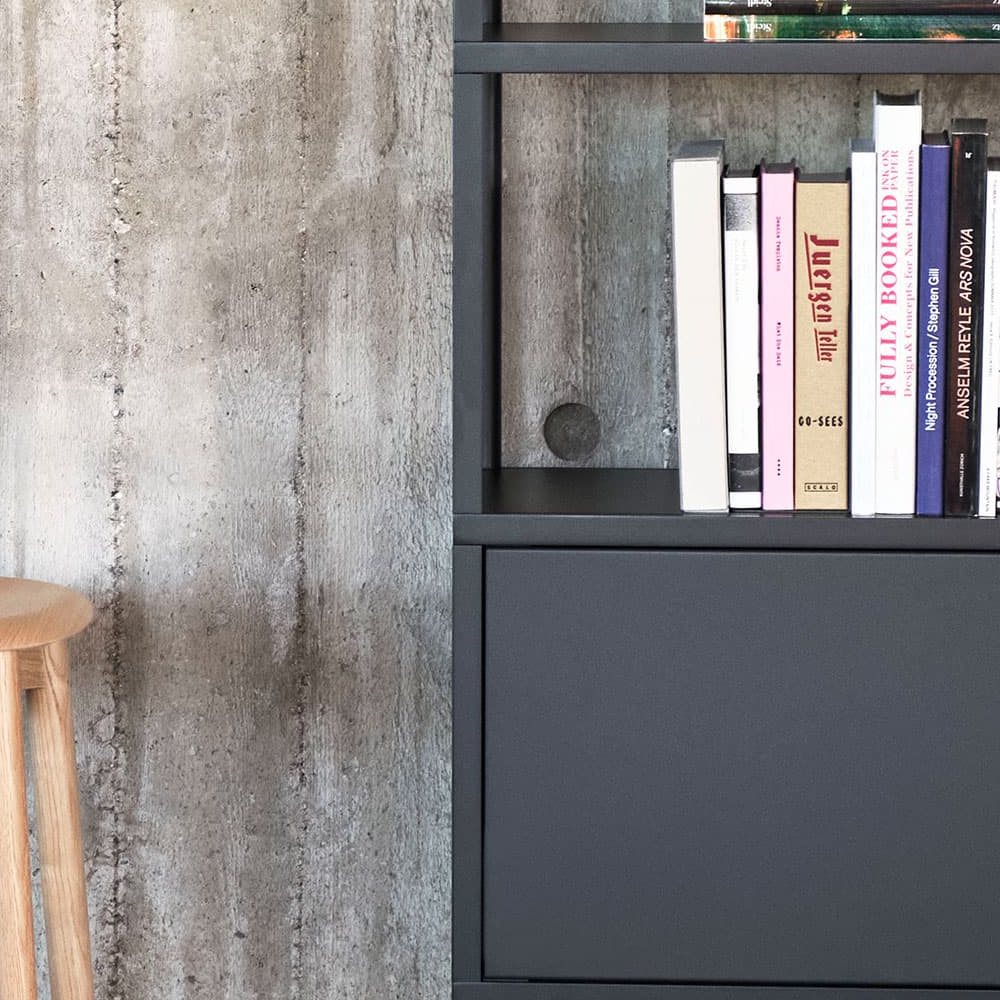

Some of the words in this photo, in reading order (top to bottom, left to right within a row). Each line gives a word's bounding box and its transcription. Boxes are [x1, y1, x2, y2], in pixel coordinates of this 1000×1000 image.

[881, 150, 890, 167] ON
[890, 150, 899, 190] PAPER
[881, 170, 889, 190] INK
[904, 149, 915, 226] Publications
[880, 195, 898, 304] BOOKED
[904, 231, 913, 256] New
[960, 228, 974, 269] NOVA
[807, 233, 839, 322] Juergen
[904, 261, 913, 279] for
[928, 268, 940, 286] Gill
[959, 270, 973, 302] ARS
[904, 282, 915, 338] Concepts
[927, 287, 940, 332] Stephen
[817, 329, 838, 362] Teller
[905, 343, 912, 352] &
[958, 307, 972, 353] REYLE
[880, 315, 897, 397] FULLY
[925, 341, 938, 401] Procession
[904, 356, 915, 397] Design
[957, 357, 971, 419] ANSELM
[798, 416, 843, 427] GO-SEES
[925, 402, 938, 431] Night
